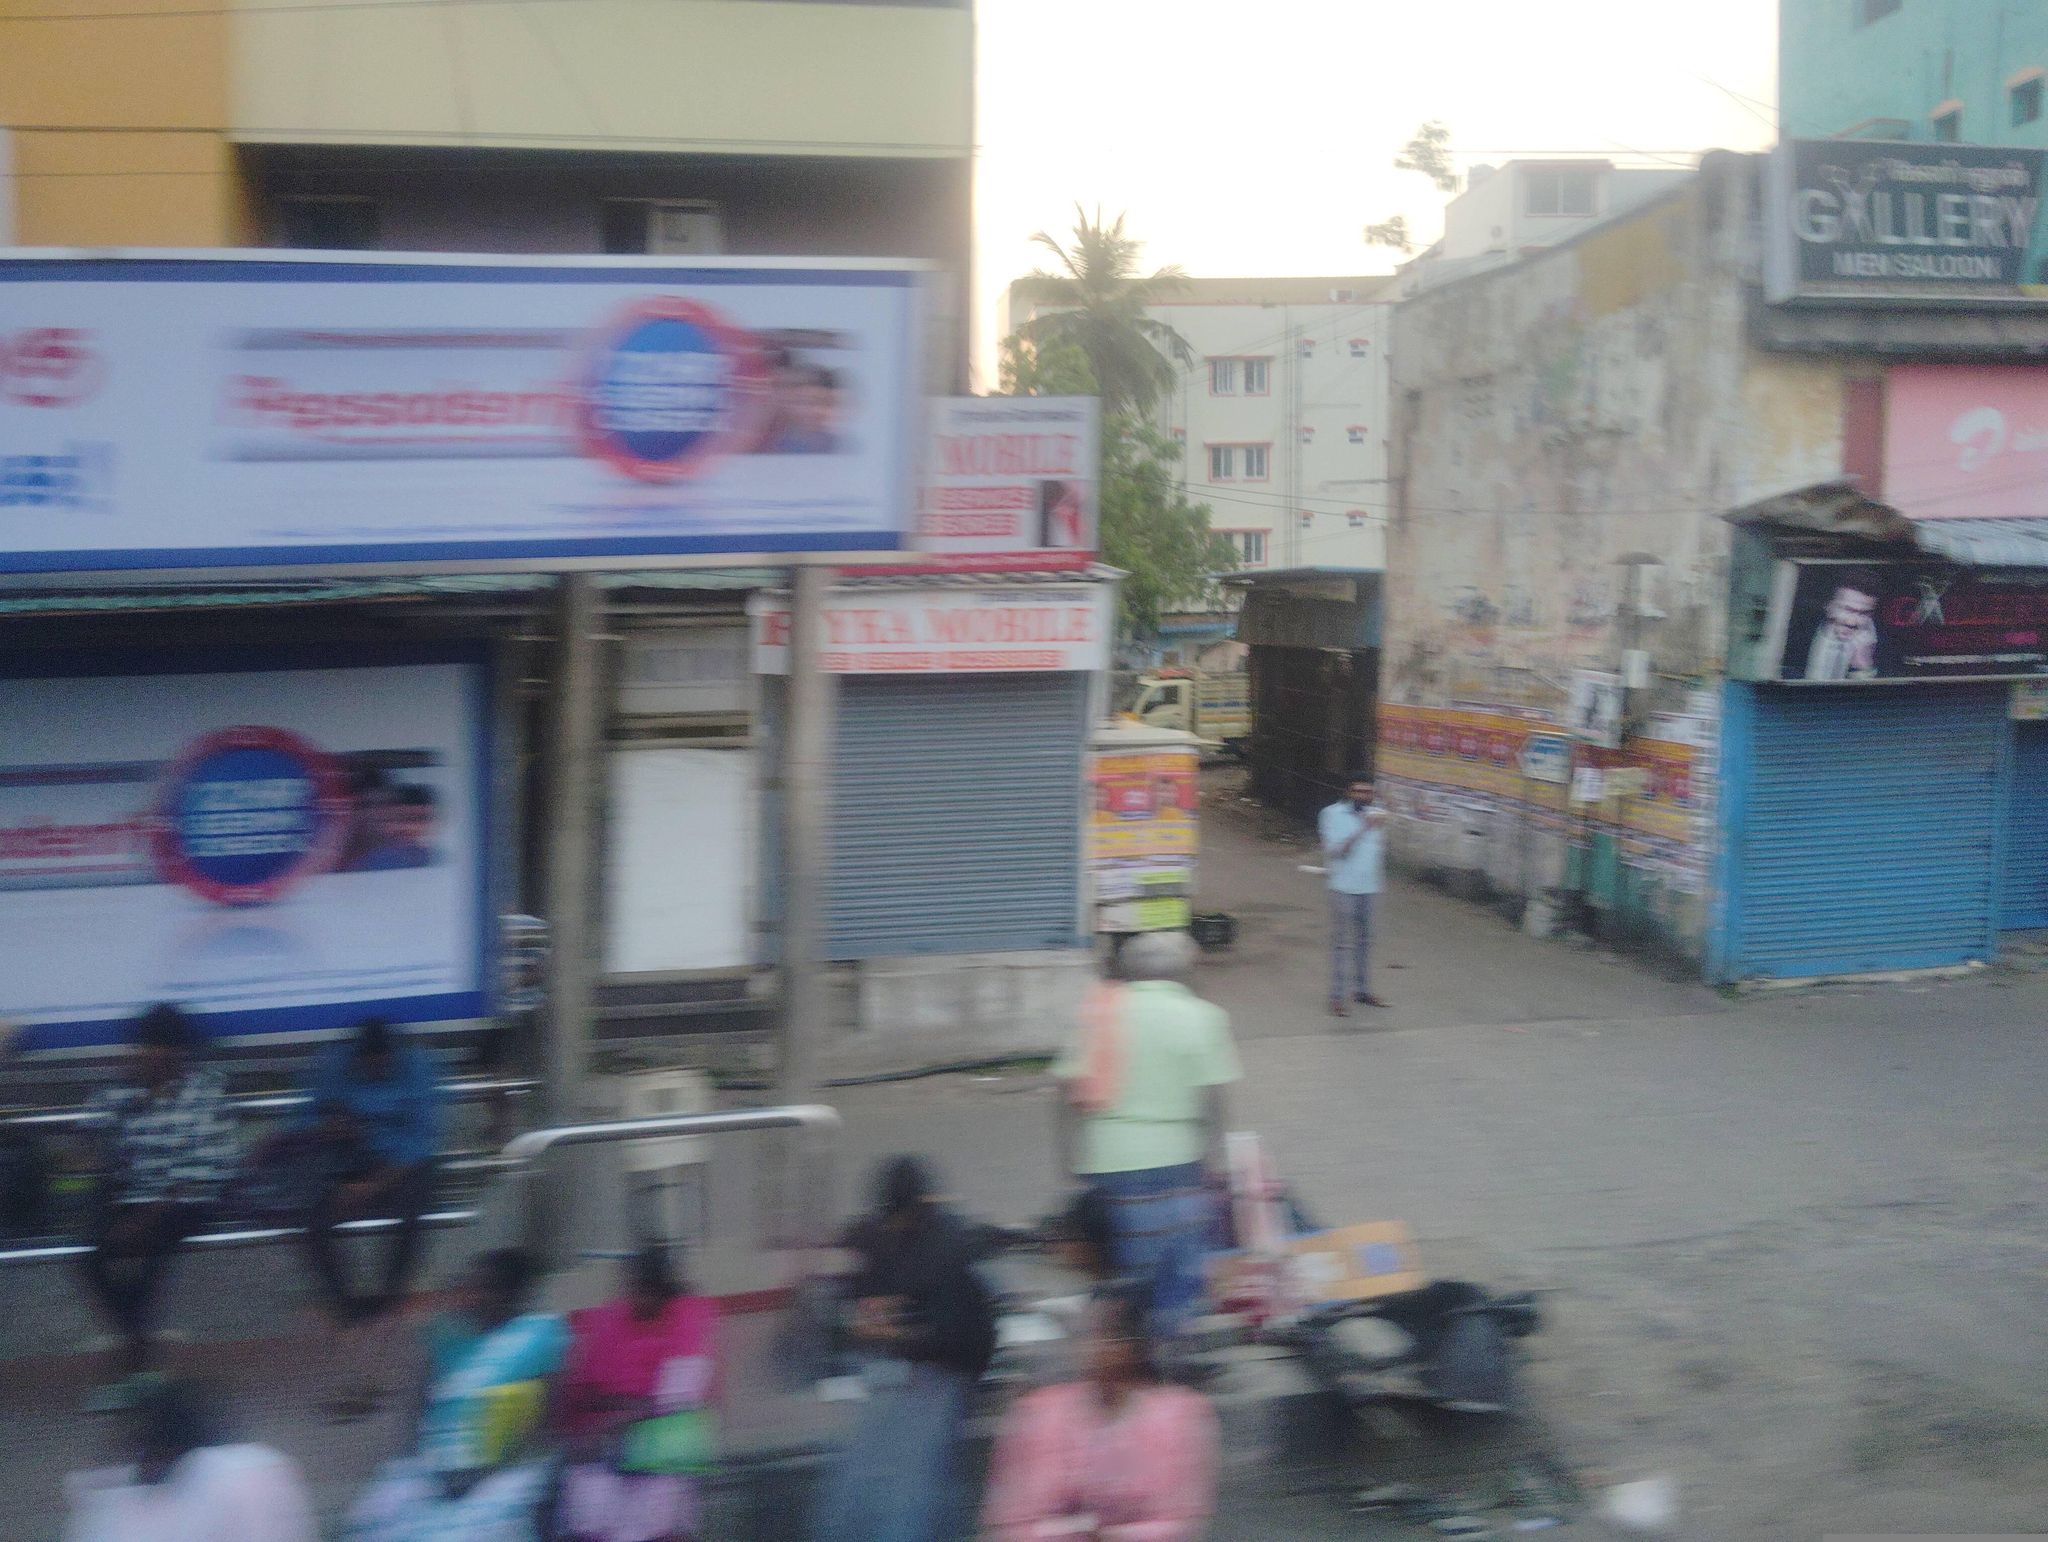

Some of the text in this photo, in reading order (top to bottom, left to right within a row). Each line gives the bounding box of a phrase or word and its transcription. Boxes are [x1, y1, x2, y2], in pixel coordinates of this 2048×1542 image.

[1832, 252, 2001, 279] MEN SALOON
[926, 606, 1094, 643] MOBILE
